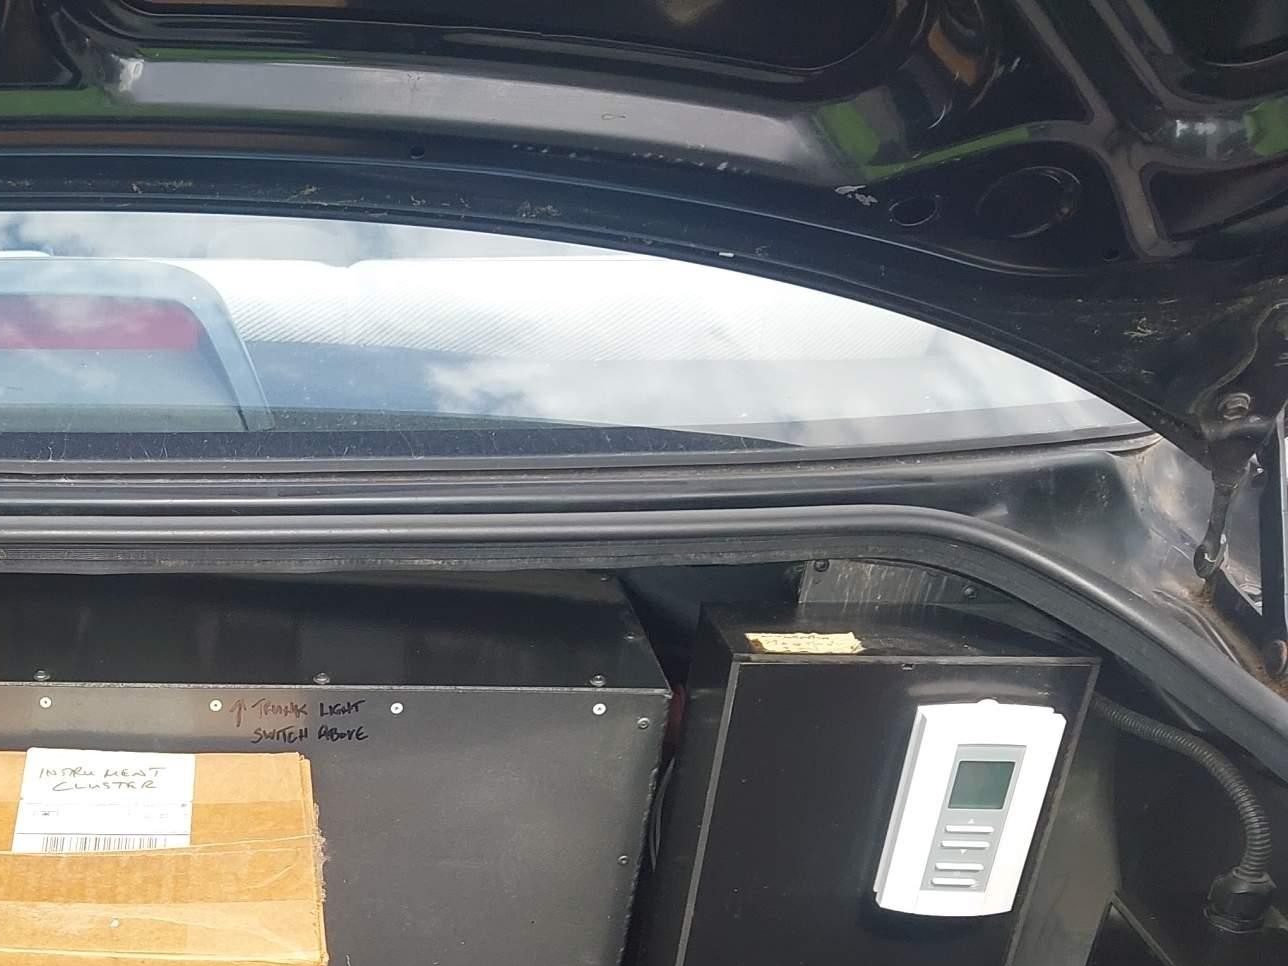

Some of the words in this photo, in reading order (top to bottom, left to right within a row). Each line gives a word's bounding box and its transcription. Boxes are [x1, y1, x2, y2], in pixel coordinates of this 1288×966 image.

[251, 698, 308, 719] TRUNK
[319, 700, 366, 717] LIGHT
[251, 725, 308, 743] SWITCH
[318, 724, 368, 742] ABOVE
[52, 779, 157, 792] CLUSTER
